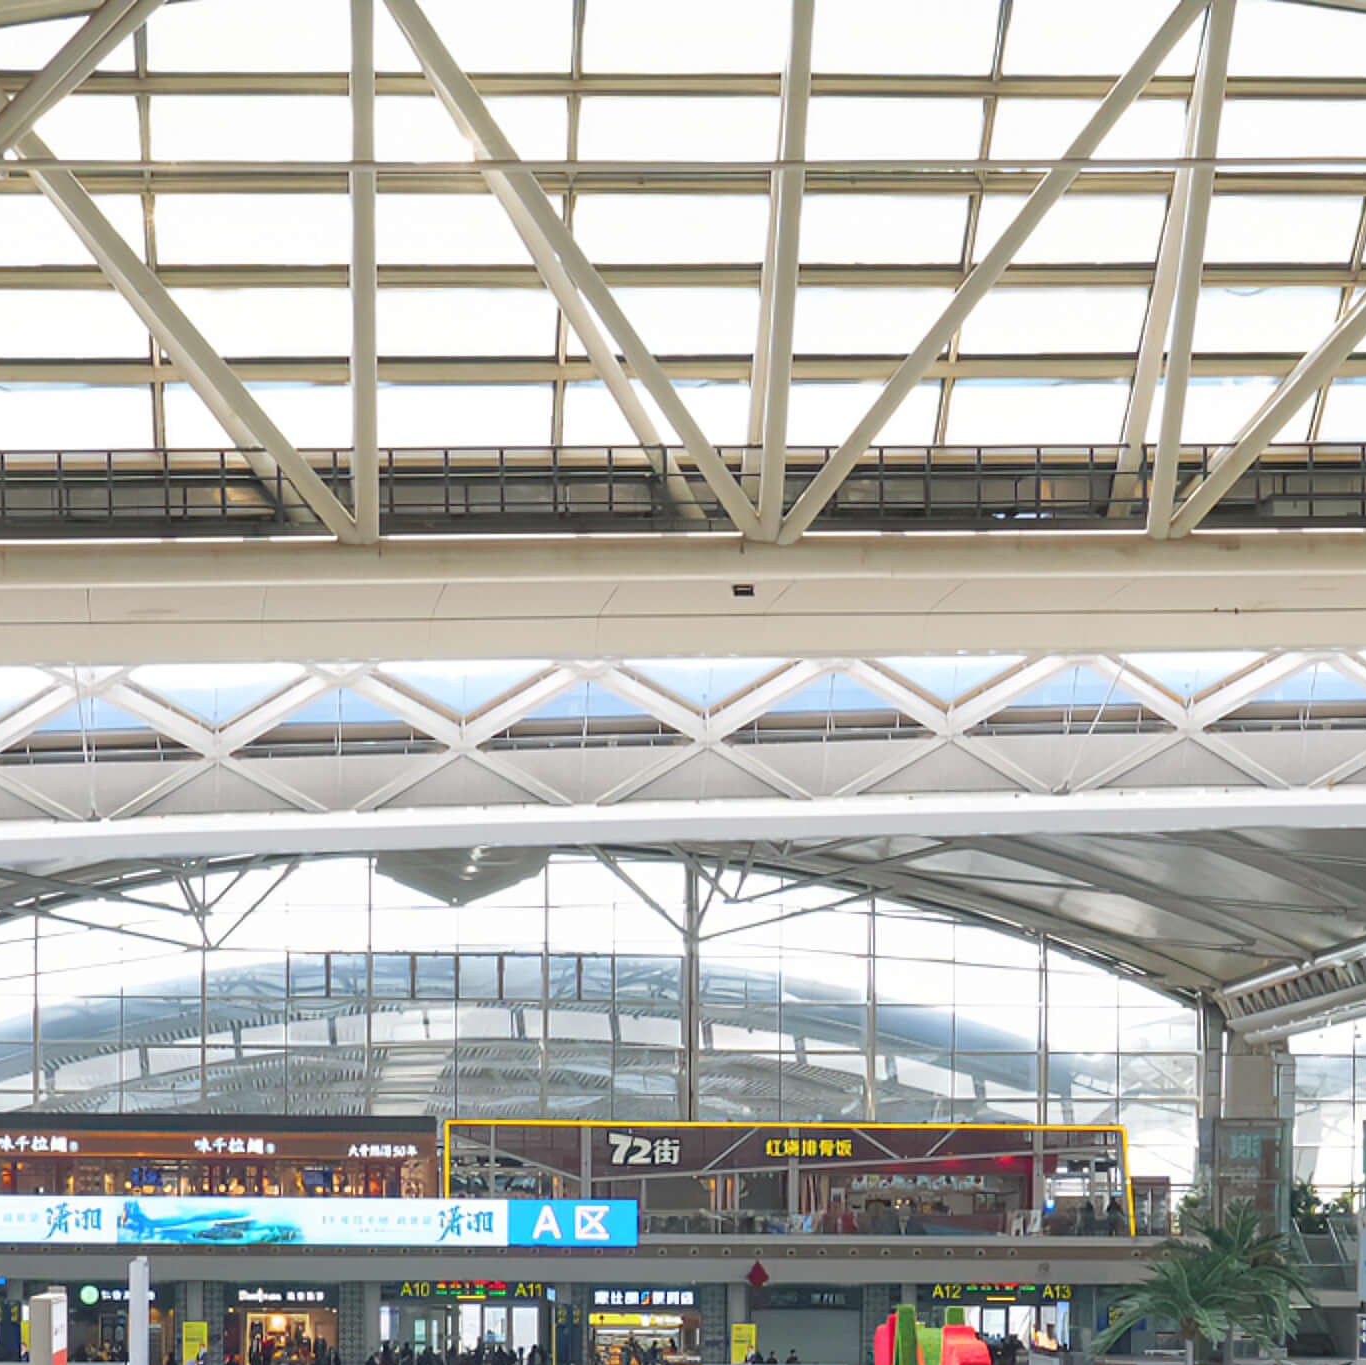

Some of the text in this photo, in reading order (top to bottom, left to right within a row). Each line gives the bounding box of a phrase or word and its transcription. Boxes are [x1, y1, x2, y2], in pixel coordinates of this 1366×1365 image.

[607, 1132, 680, 1165] 72街
[400, 1282, 430, 1297] A10
[515, 1282, 542, 1297] A11
[932, 1284, 962, 1299] A12
[1042, 1284, 1072, 1299] A13
